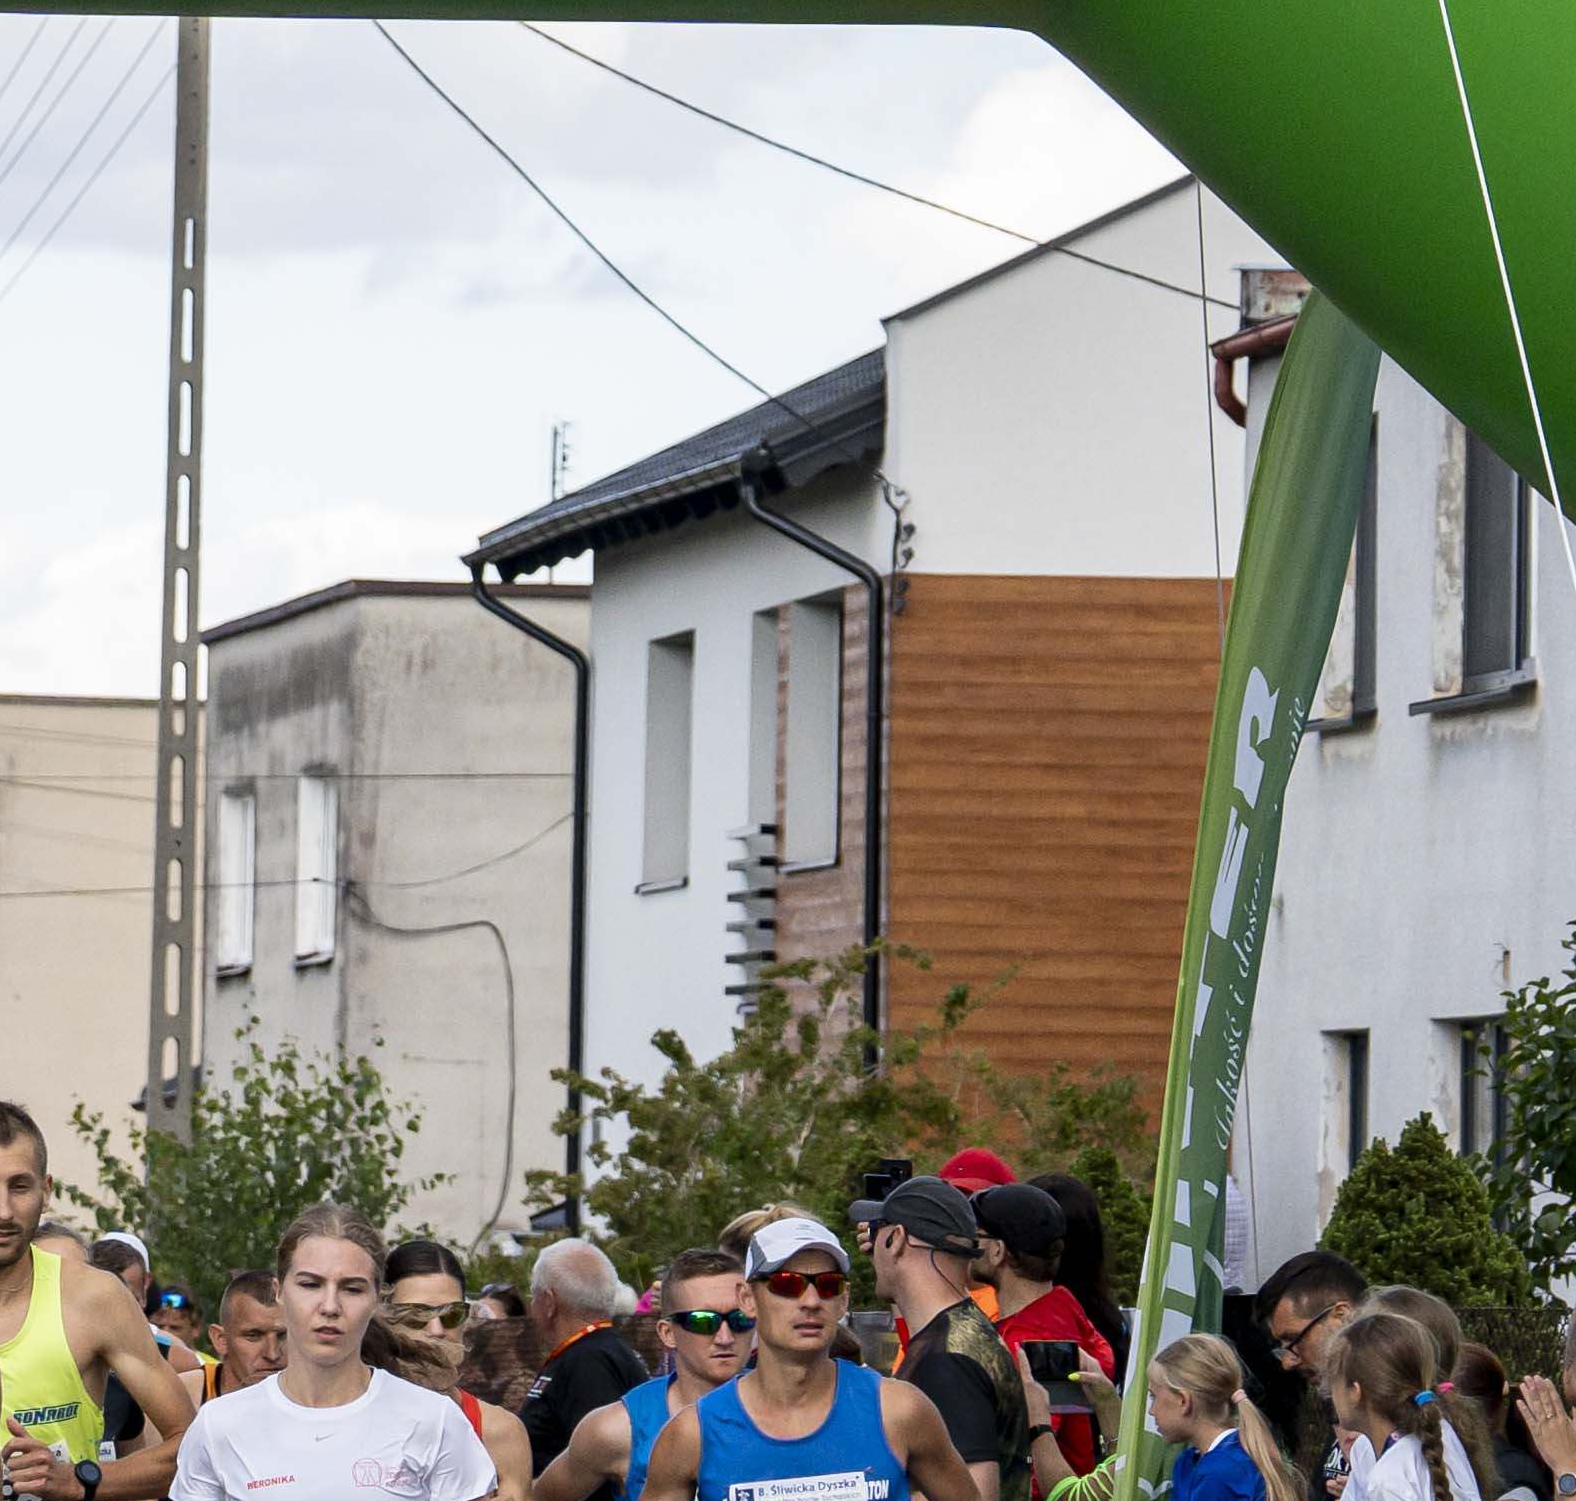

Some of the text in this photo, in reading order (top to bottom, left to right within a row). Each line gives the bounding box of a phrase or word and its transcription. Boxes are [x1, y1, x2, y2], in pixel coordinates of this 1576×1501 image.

[246, 1473, 296, 1491] WERONIKA
[771, 1483, 815, 1497] Śliwicka
[817, 1478, 858, 1493] Dyszka
